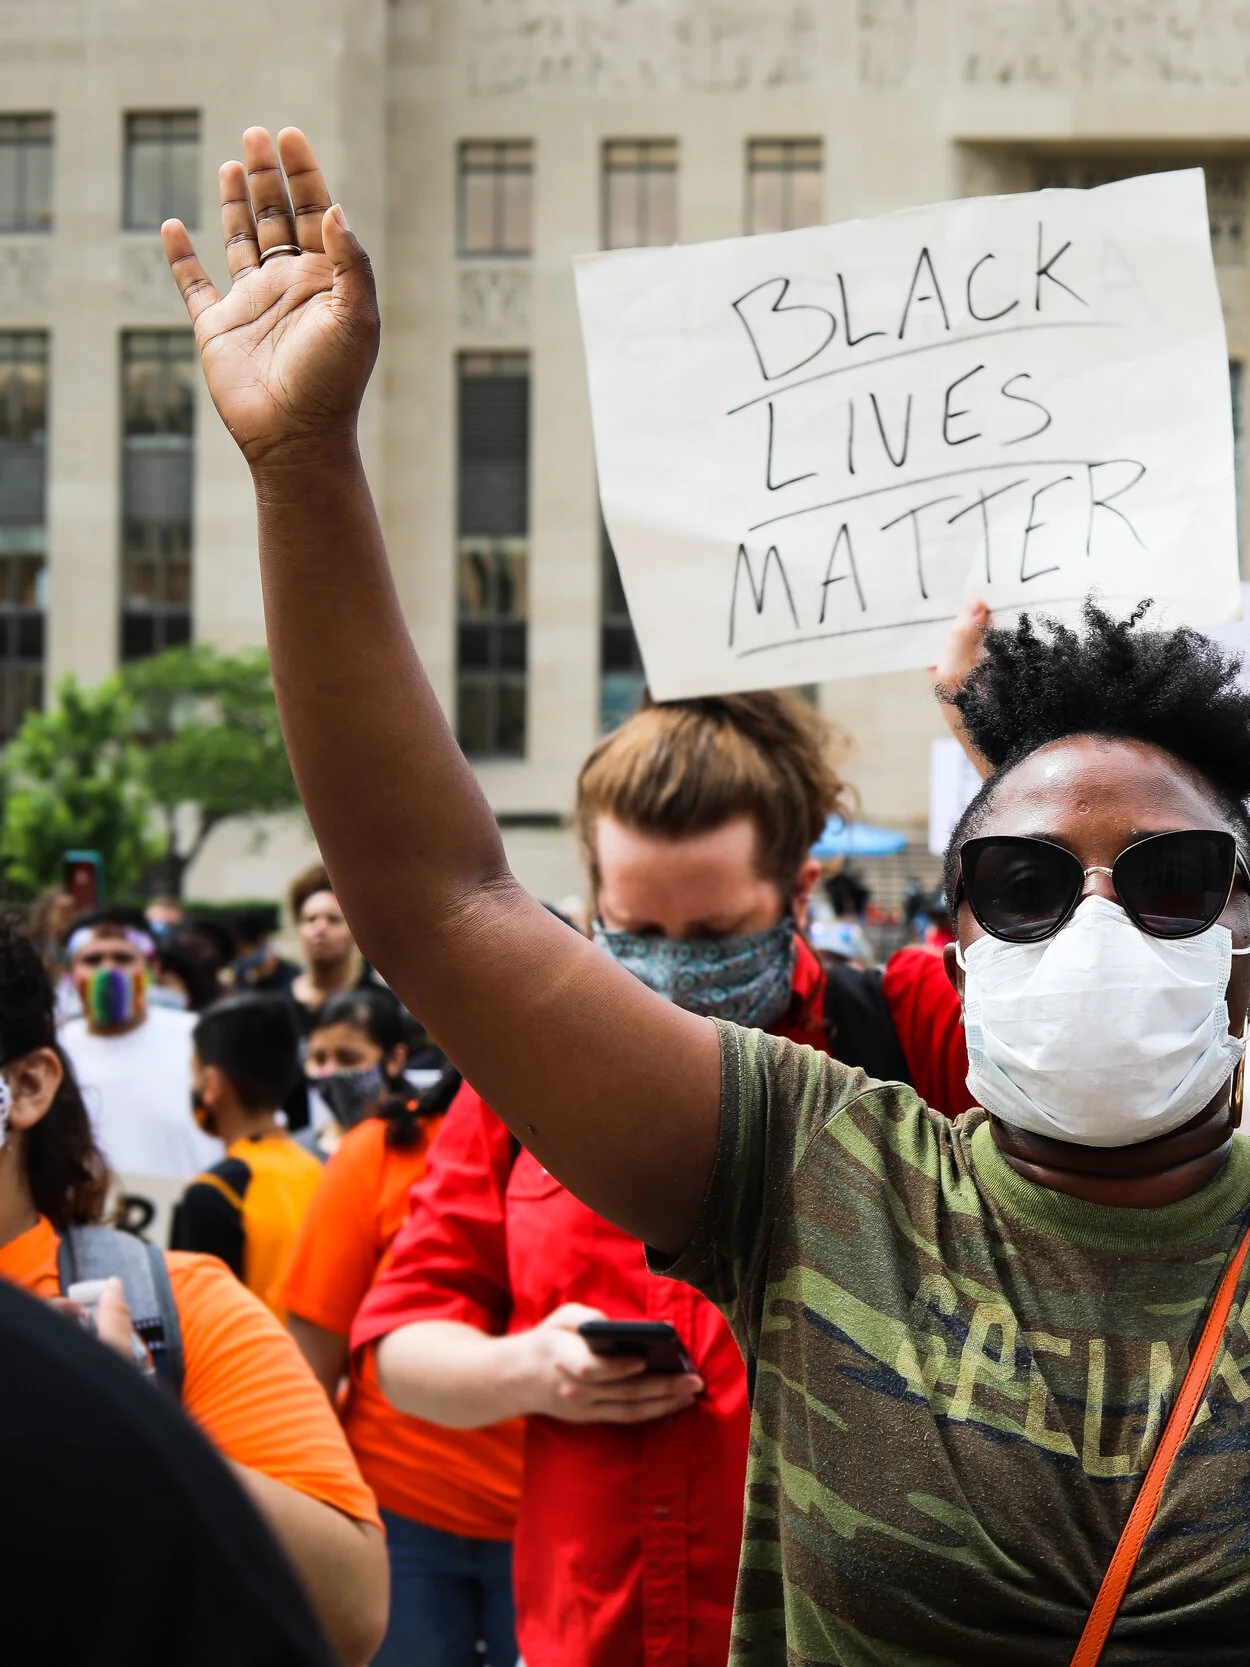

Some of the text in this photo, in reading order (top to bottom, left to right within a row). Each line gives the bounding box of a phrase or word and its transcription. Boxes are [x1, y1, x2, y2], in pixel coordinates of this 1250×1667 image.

[731, 221, 1090, 381] BLACK
[766, 364, 1052, 491] LIVES
[728, 459, 1148, 648] MATTER
